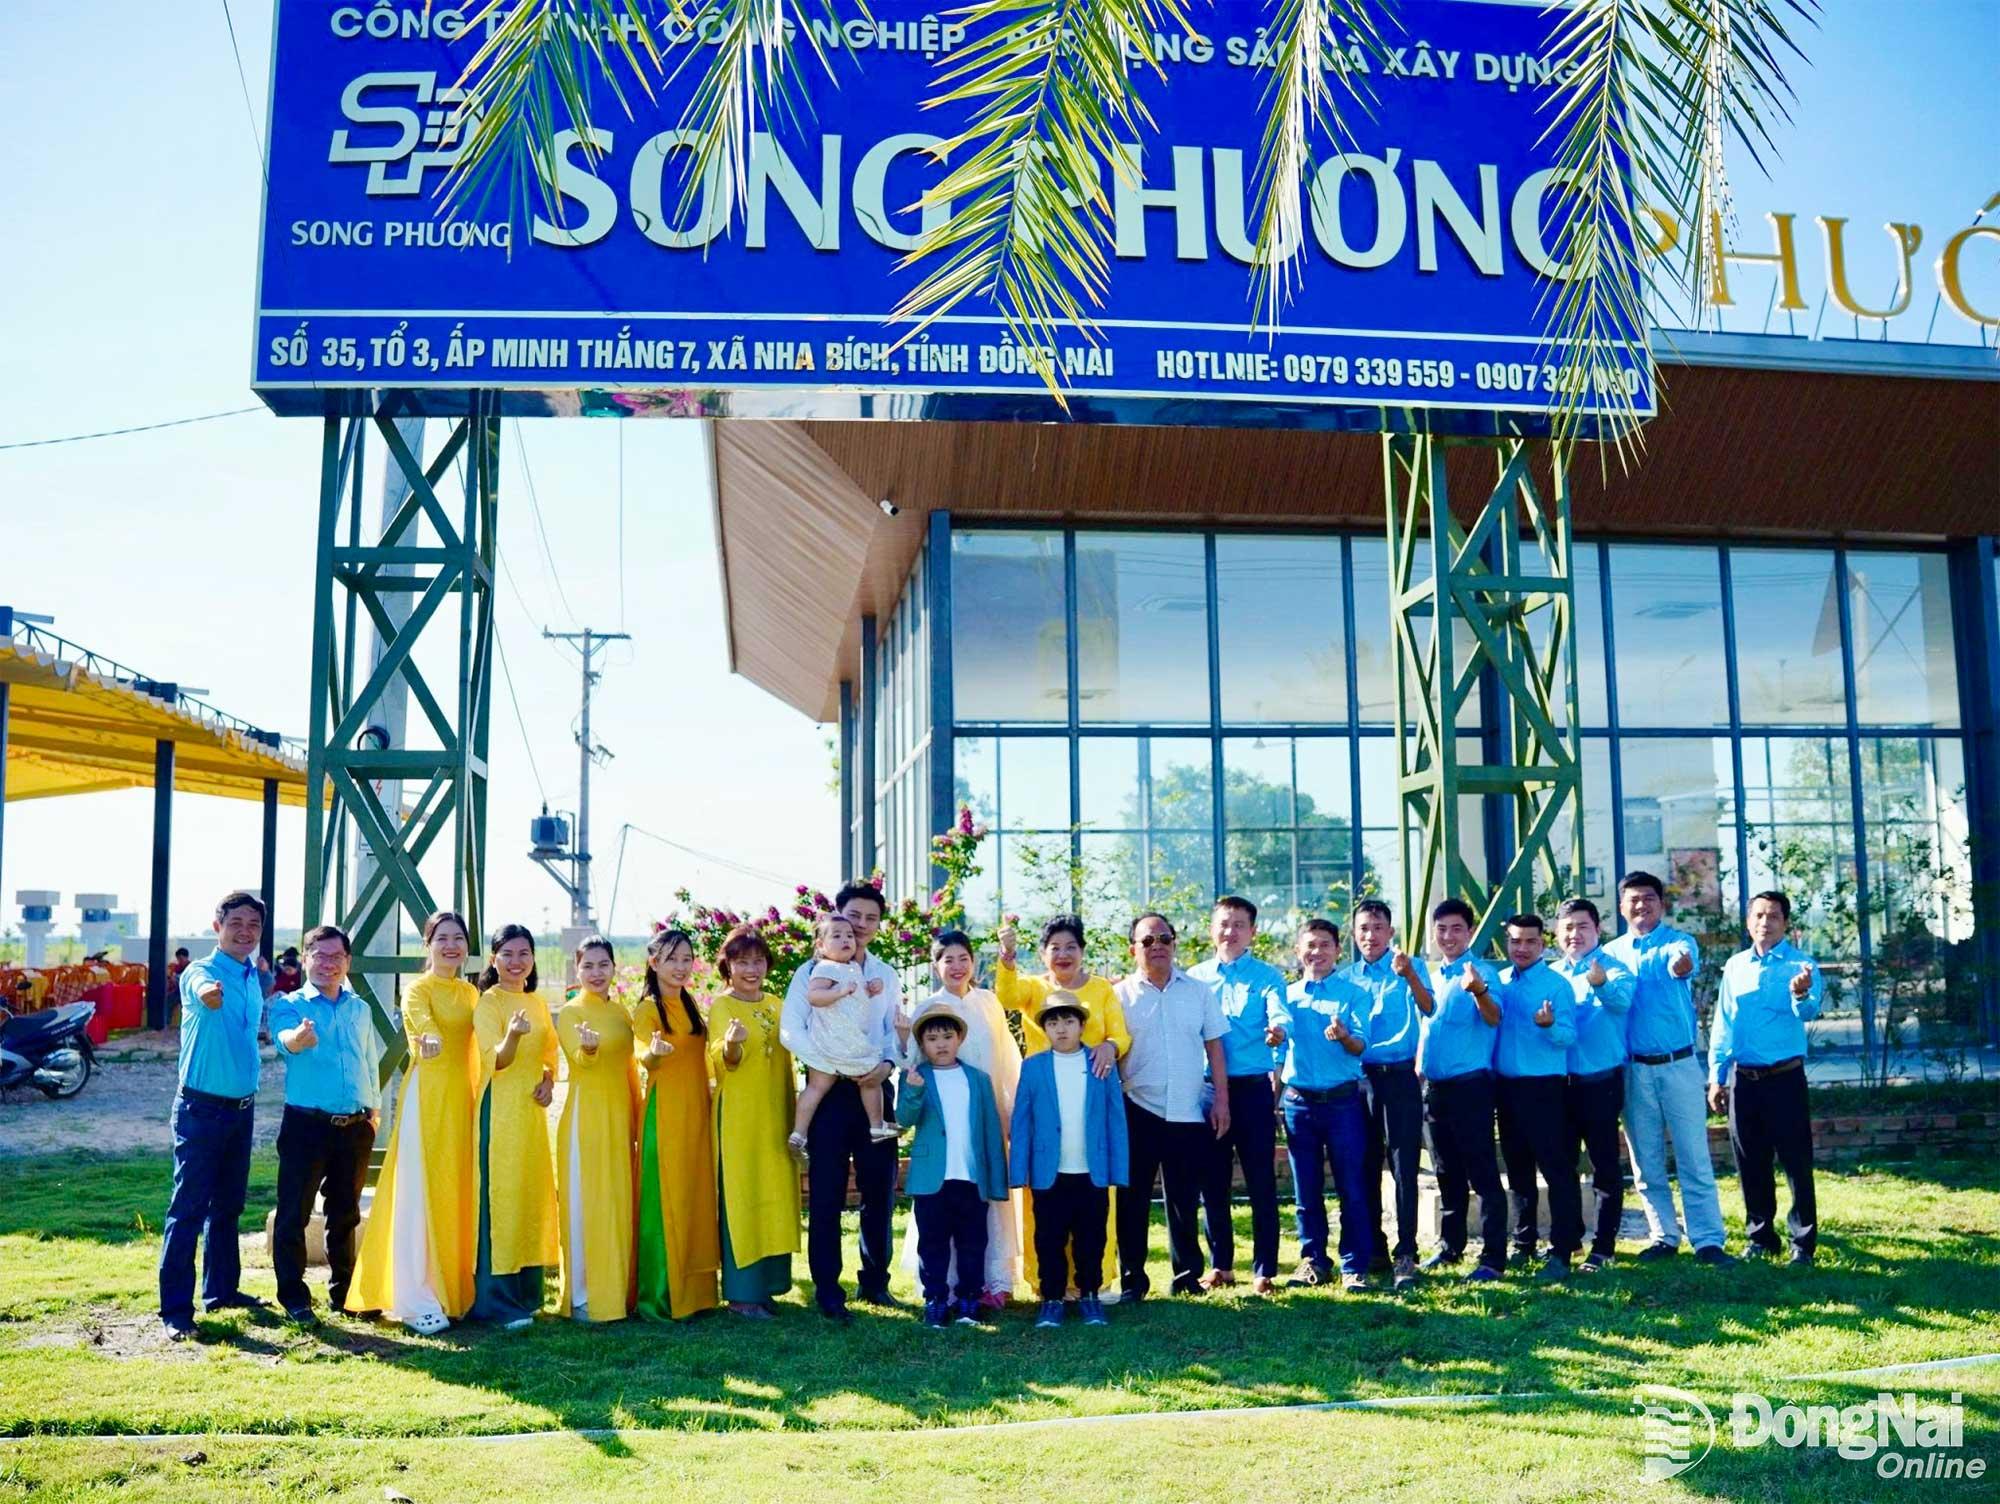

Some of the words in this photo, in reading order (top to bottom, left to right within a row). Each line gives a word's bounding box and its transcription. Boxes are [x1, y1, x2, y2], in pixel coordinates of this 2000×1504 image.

[330, 0, 466, 39] CÔNG
[812, 14, 966, 60] NGHIỆP
[1383, 40, 1461, 80] XÂY
[532, 127, 954, 253] SONG
[291, 220, 374, 246] SONG
[270, 321, 310, 366] SỐ
[370, 321, 408, 367] TỔ
[445, 322, 486, 367] ẤP
[491, 338, 569, 368] MINH
[706, 335, 749, 371] XÃ
[754, 340, 816, 371] NHA
[904, 333, 969, 373] TỈNH
[1064, 347, 1115, 377] NAI
[1156, 349, 1279, 382] HOTLNIE:
[1283, 354, 1350, 384] 0979
[1354, 357, 1403, 386] 339
[1406, 359, 1455, 388] 559
[1475, 361, 1539, 391] 0907
